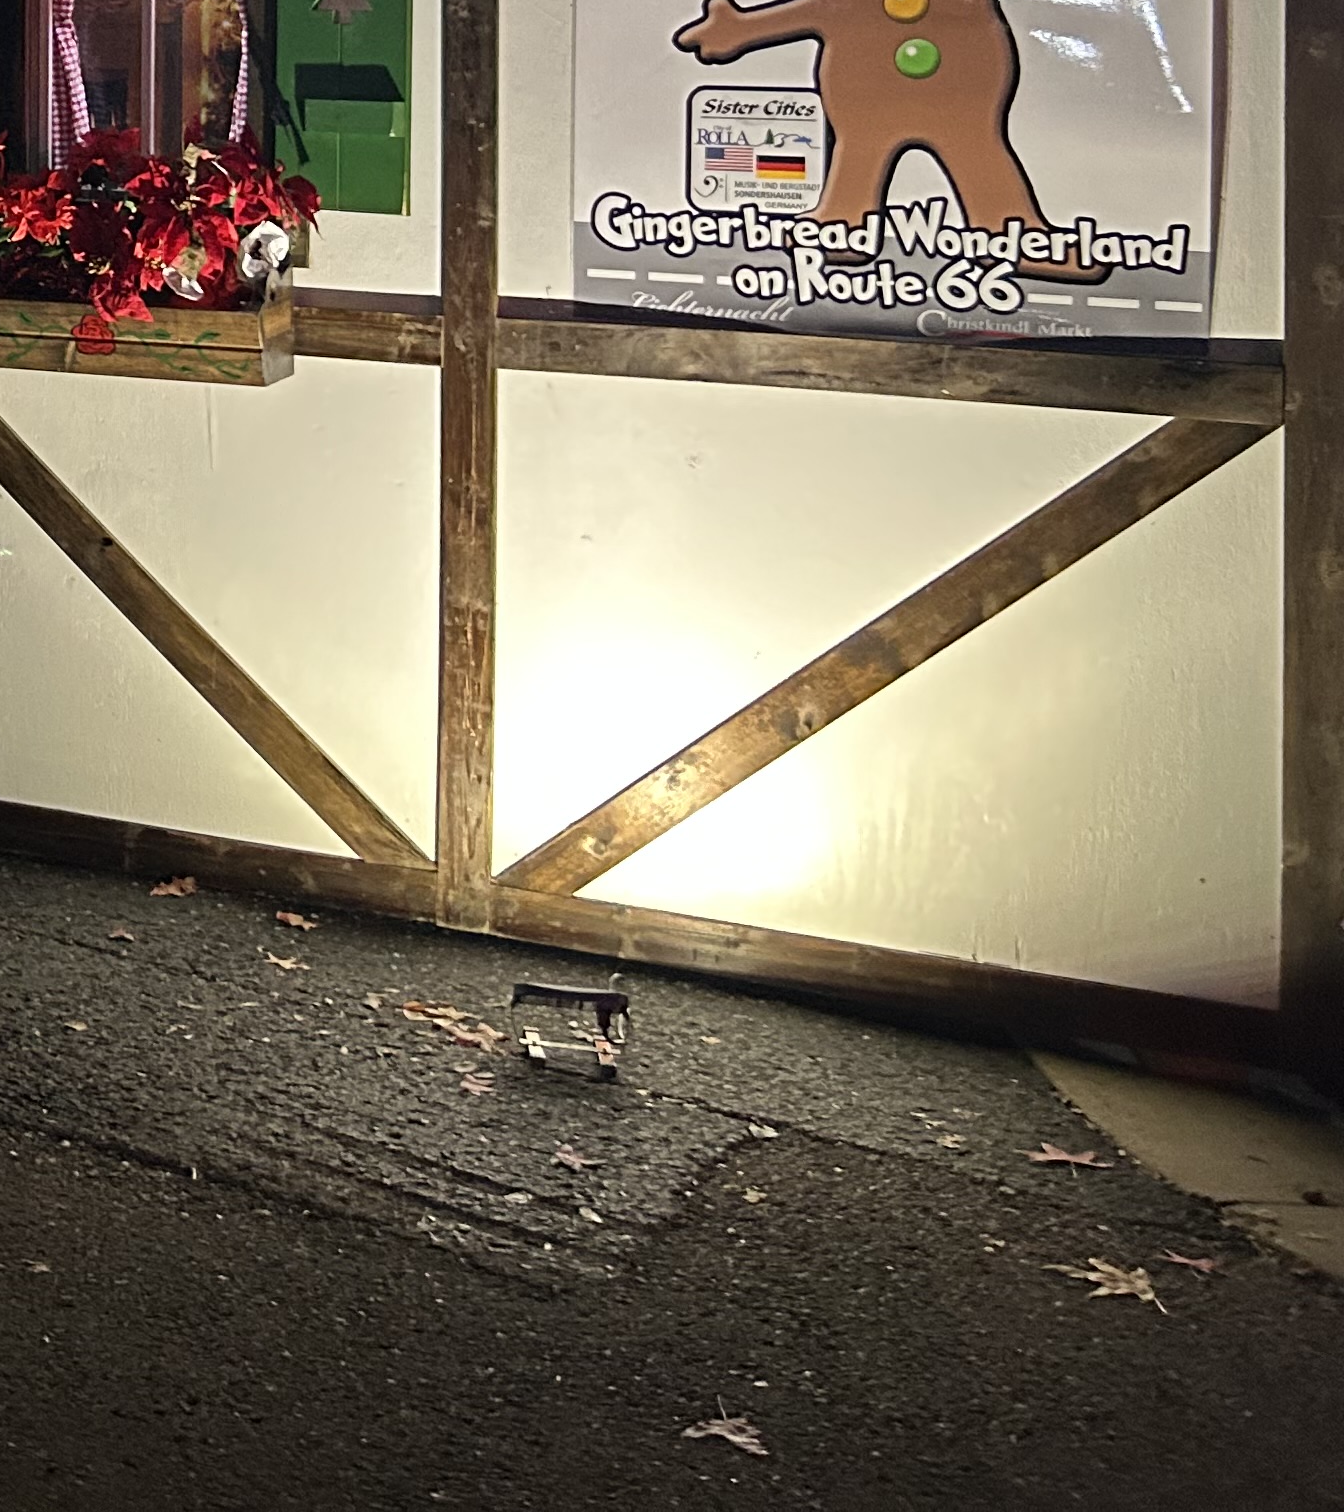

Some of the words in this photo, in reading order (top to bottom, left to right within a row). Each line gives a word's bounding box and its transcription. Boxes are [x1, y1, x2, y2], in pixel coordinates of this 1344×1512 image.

[702, 98, 759, 115] Sister
[763, 100, 817, 117] Cities
[697, 128, 750, 145] ROLLA
[734, 190, 802, 200] SONDERSHAUSEN
[765, 201, 808, 209] GERMANY
[593, 194, 879, 256] Gingerbread
[889, 199, 1187, 271] Wonderland
[734, 267, 785, 297] on
[793, 247, 924, 306] Route
[935, 259, 1022, 312] 66
[916, 309, 1030, 336] Christkindl
[1038, 320, 1094, 337] Markt
